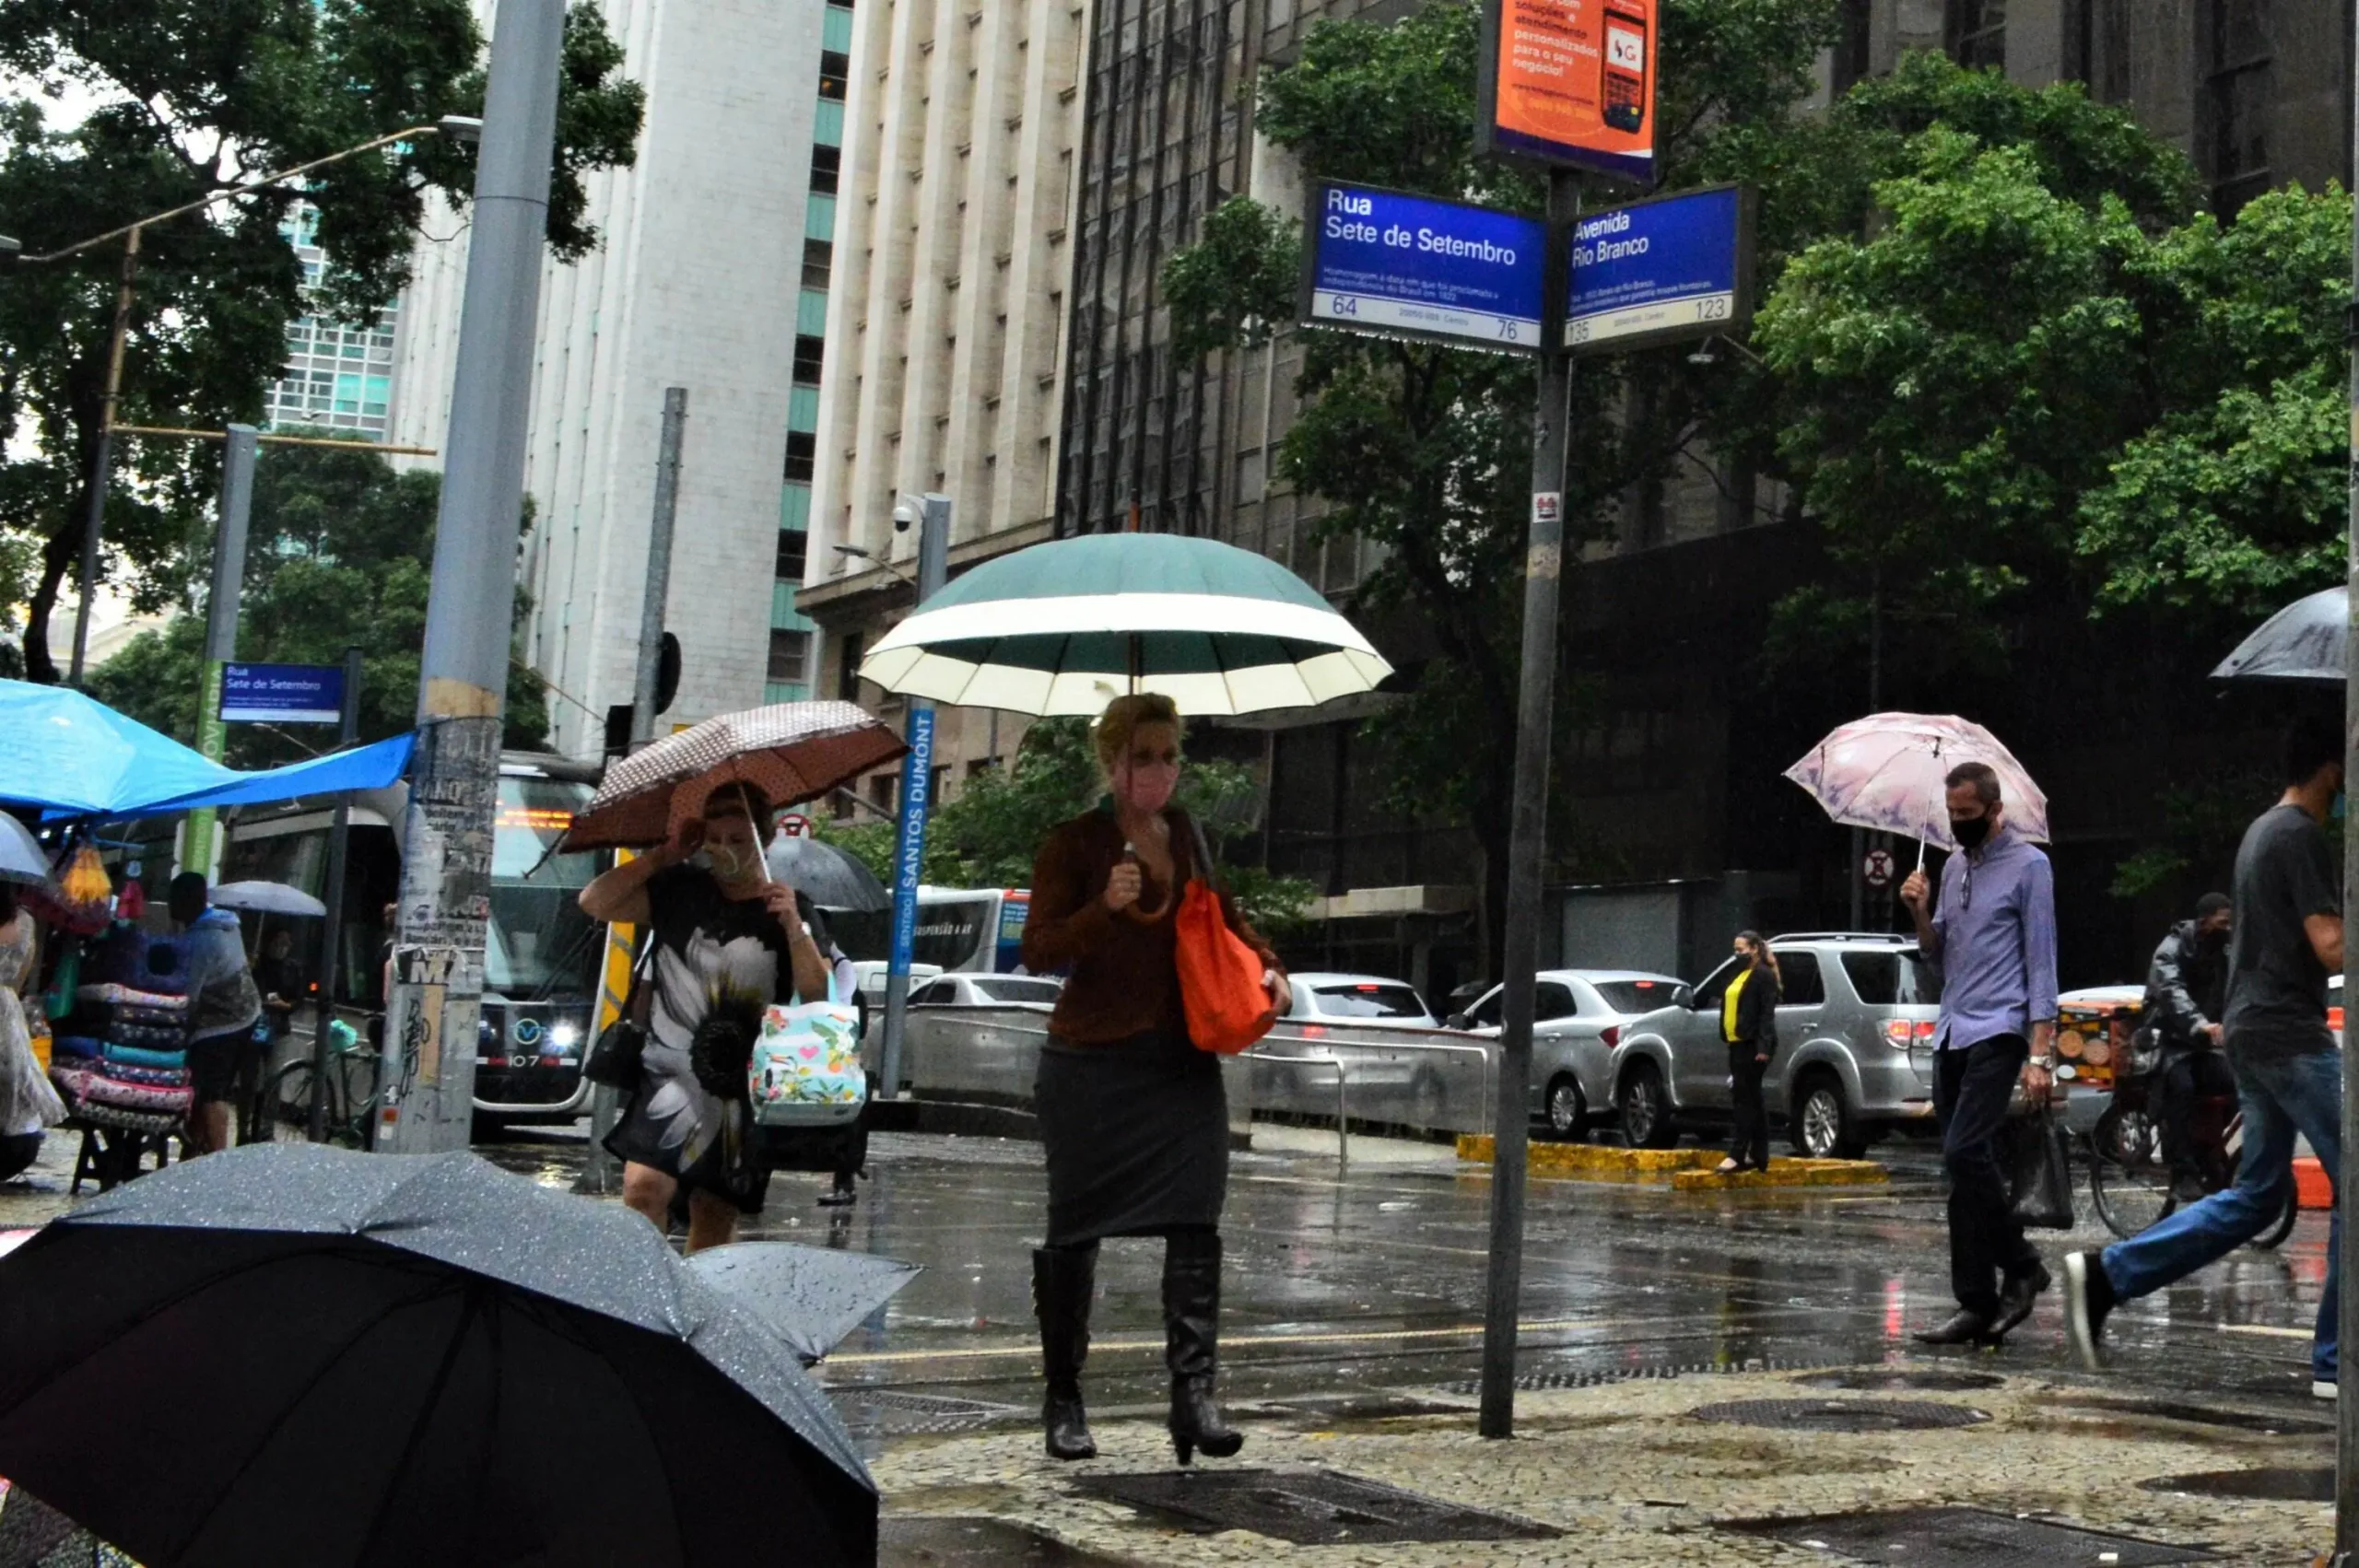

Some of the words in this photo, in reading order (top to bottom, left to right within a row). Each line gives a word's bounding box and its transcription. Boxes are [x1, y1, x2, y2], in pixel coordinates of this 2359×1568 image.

[1514, 15, 1588, 40] atendimento
[1512, 44, 1540, 58] para
[1553, 53, 1574, 65] seu
[1514, 29, 1599, 57] personalizados
[1327, 189, 1372, 216] Rua
[1573, 210, 1630, 242] Avenida
[1325, 216, 1378, 243] Sete
[1384, 224, 1412, 249] de
[1417, 228, 1517, 266] Setembro
[1572, 246, 1593, 269] Rio
[1597, 236, 1649, 263] Branco
[1332, 296, 1357, 317] 64
[1497, 319, 1518, 340] 76
[1695, 298, 1726, 320] 123
[227, 666, 249, 676] Rua
[227, 678, 251, 689] Sete
[252, 679, 268, 689] de
[270, 679, 321, 691] Setembro
[910, 716, 932, 802] DUMONT
[902, 807, 924, 889] SANTOS
[508, 1055, 540, 1068] 107
